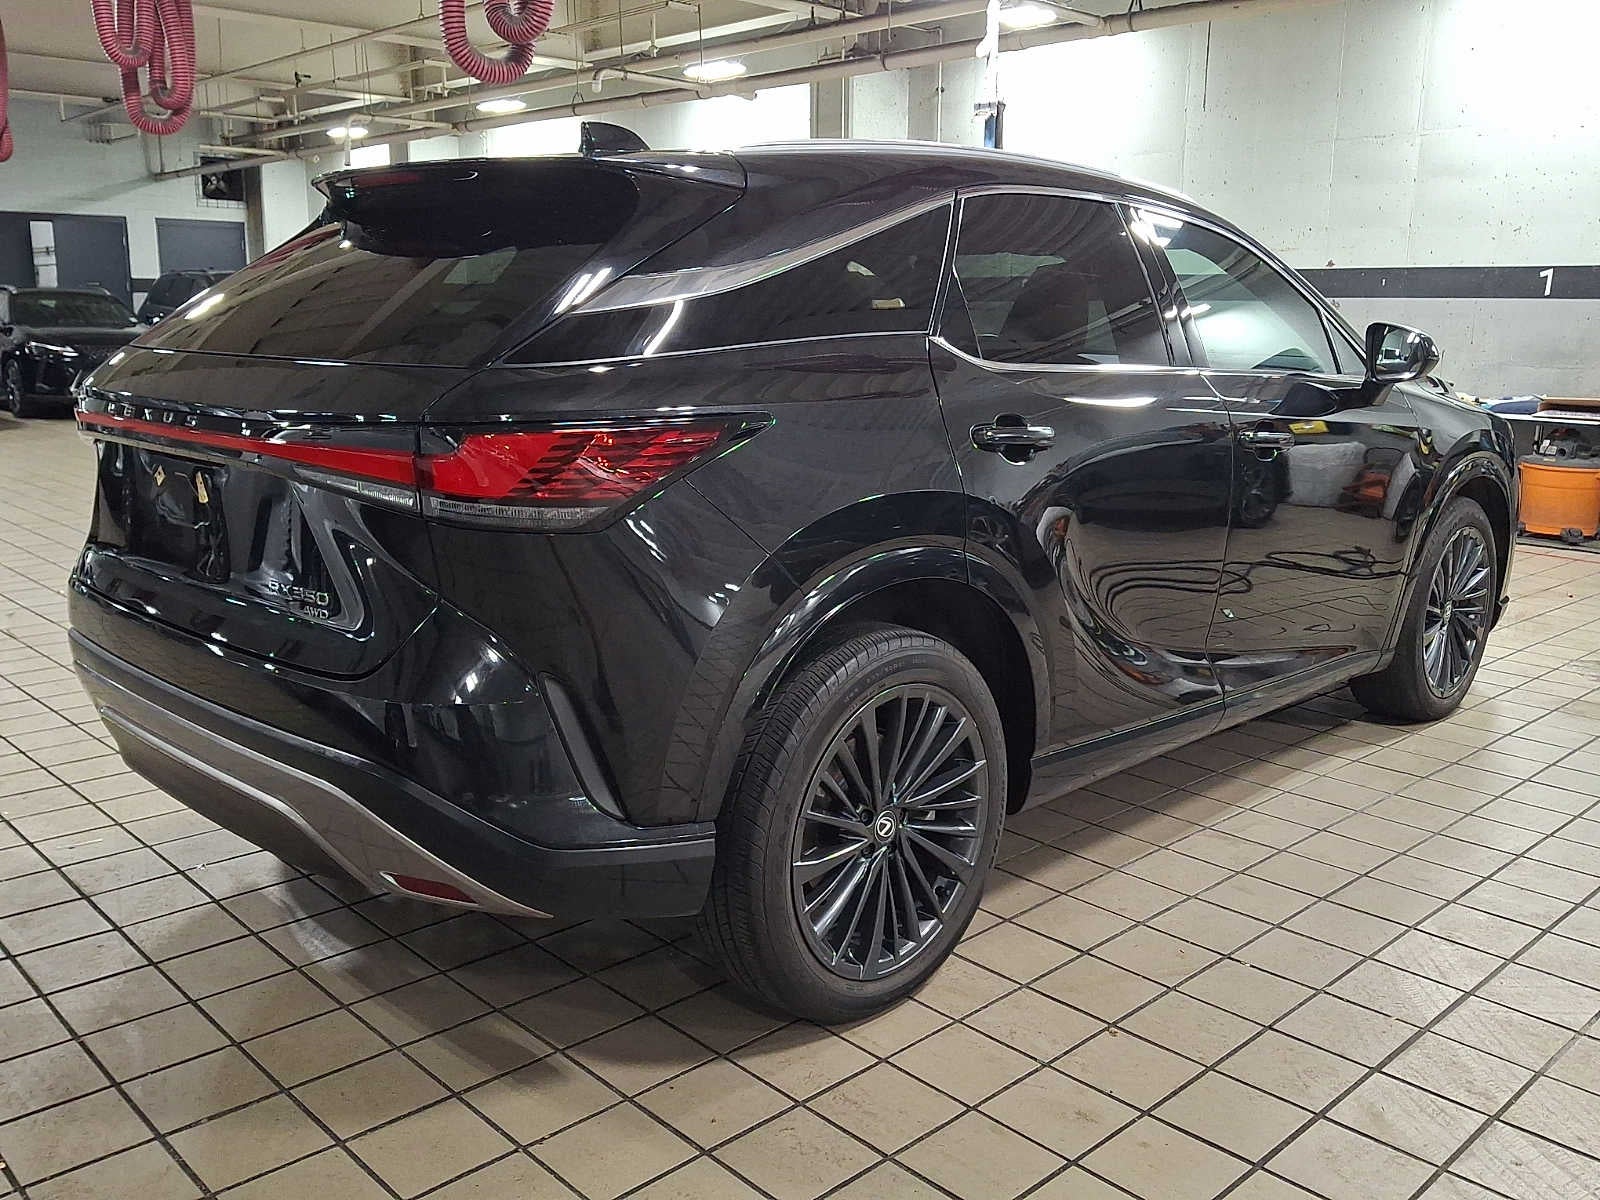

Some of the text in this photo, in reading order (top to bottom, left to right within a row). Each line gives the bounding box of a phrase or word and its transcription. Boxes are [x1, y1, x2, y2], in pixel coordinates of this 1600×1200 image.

[1540, 267, 1554, 297] 1
[107, 401, 199, 427] LEXUS
[304, 605, 329, 619] AWD
